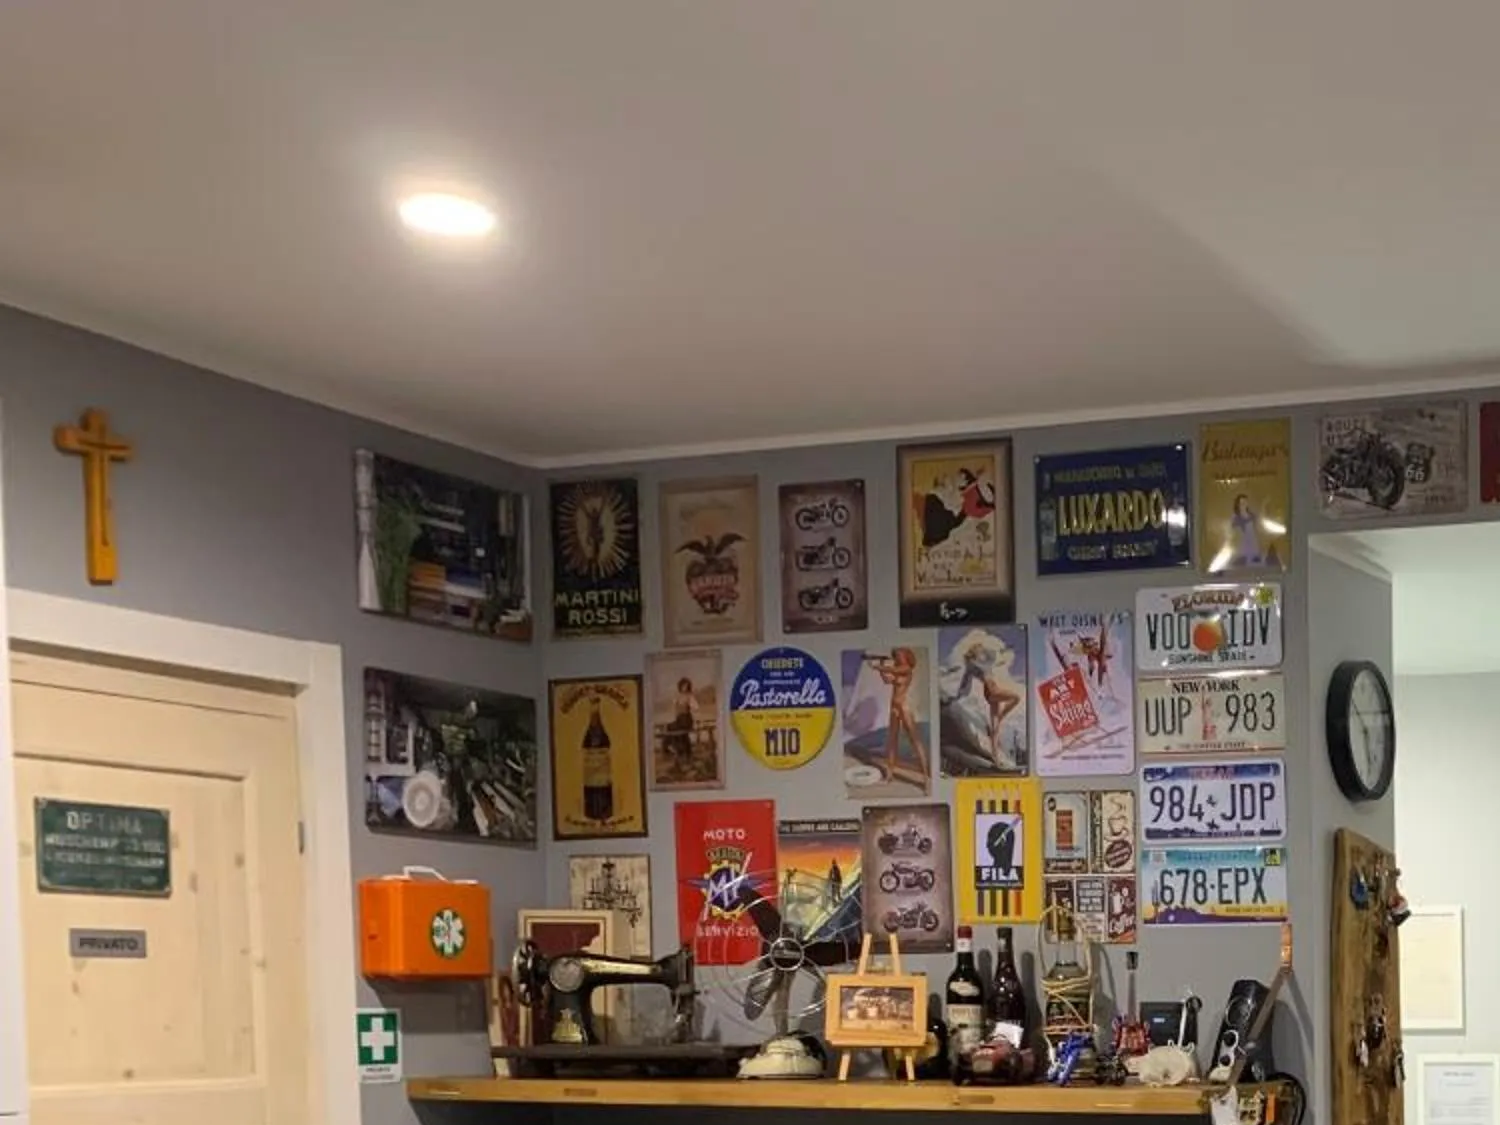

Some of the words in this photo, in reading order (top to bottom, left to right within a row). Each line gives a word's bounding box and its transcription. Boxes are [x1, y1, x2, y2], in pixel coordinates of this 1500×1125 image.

[1058, 487, 1164, 537] LUXARDO
[555, 589, 640, 608] MARTINI
[568, 607, 628, 625] ROSSI
[738, 678, 827, 709] Pastorella
[1171, 681, 1201, 694] NEW
[1205, 679, 1241, 693] YORK
[1144, 694, 1192, 737] UUP
[1225, 690, 1276, 733] 983
[764, 728, 800, 756] MIO
[1149, 785, 1204, 823] 984
[1219, 782, 1276, 821] JDP
[703, 828, 747, 841] MOTO
[980, 866, 1020, 881] FILA
[1159, 868, 1208, 906] 678
[1217, 867, 1268, 905] EPX
[78, 936, 139, 952] PRIVATO
